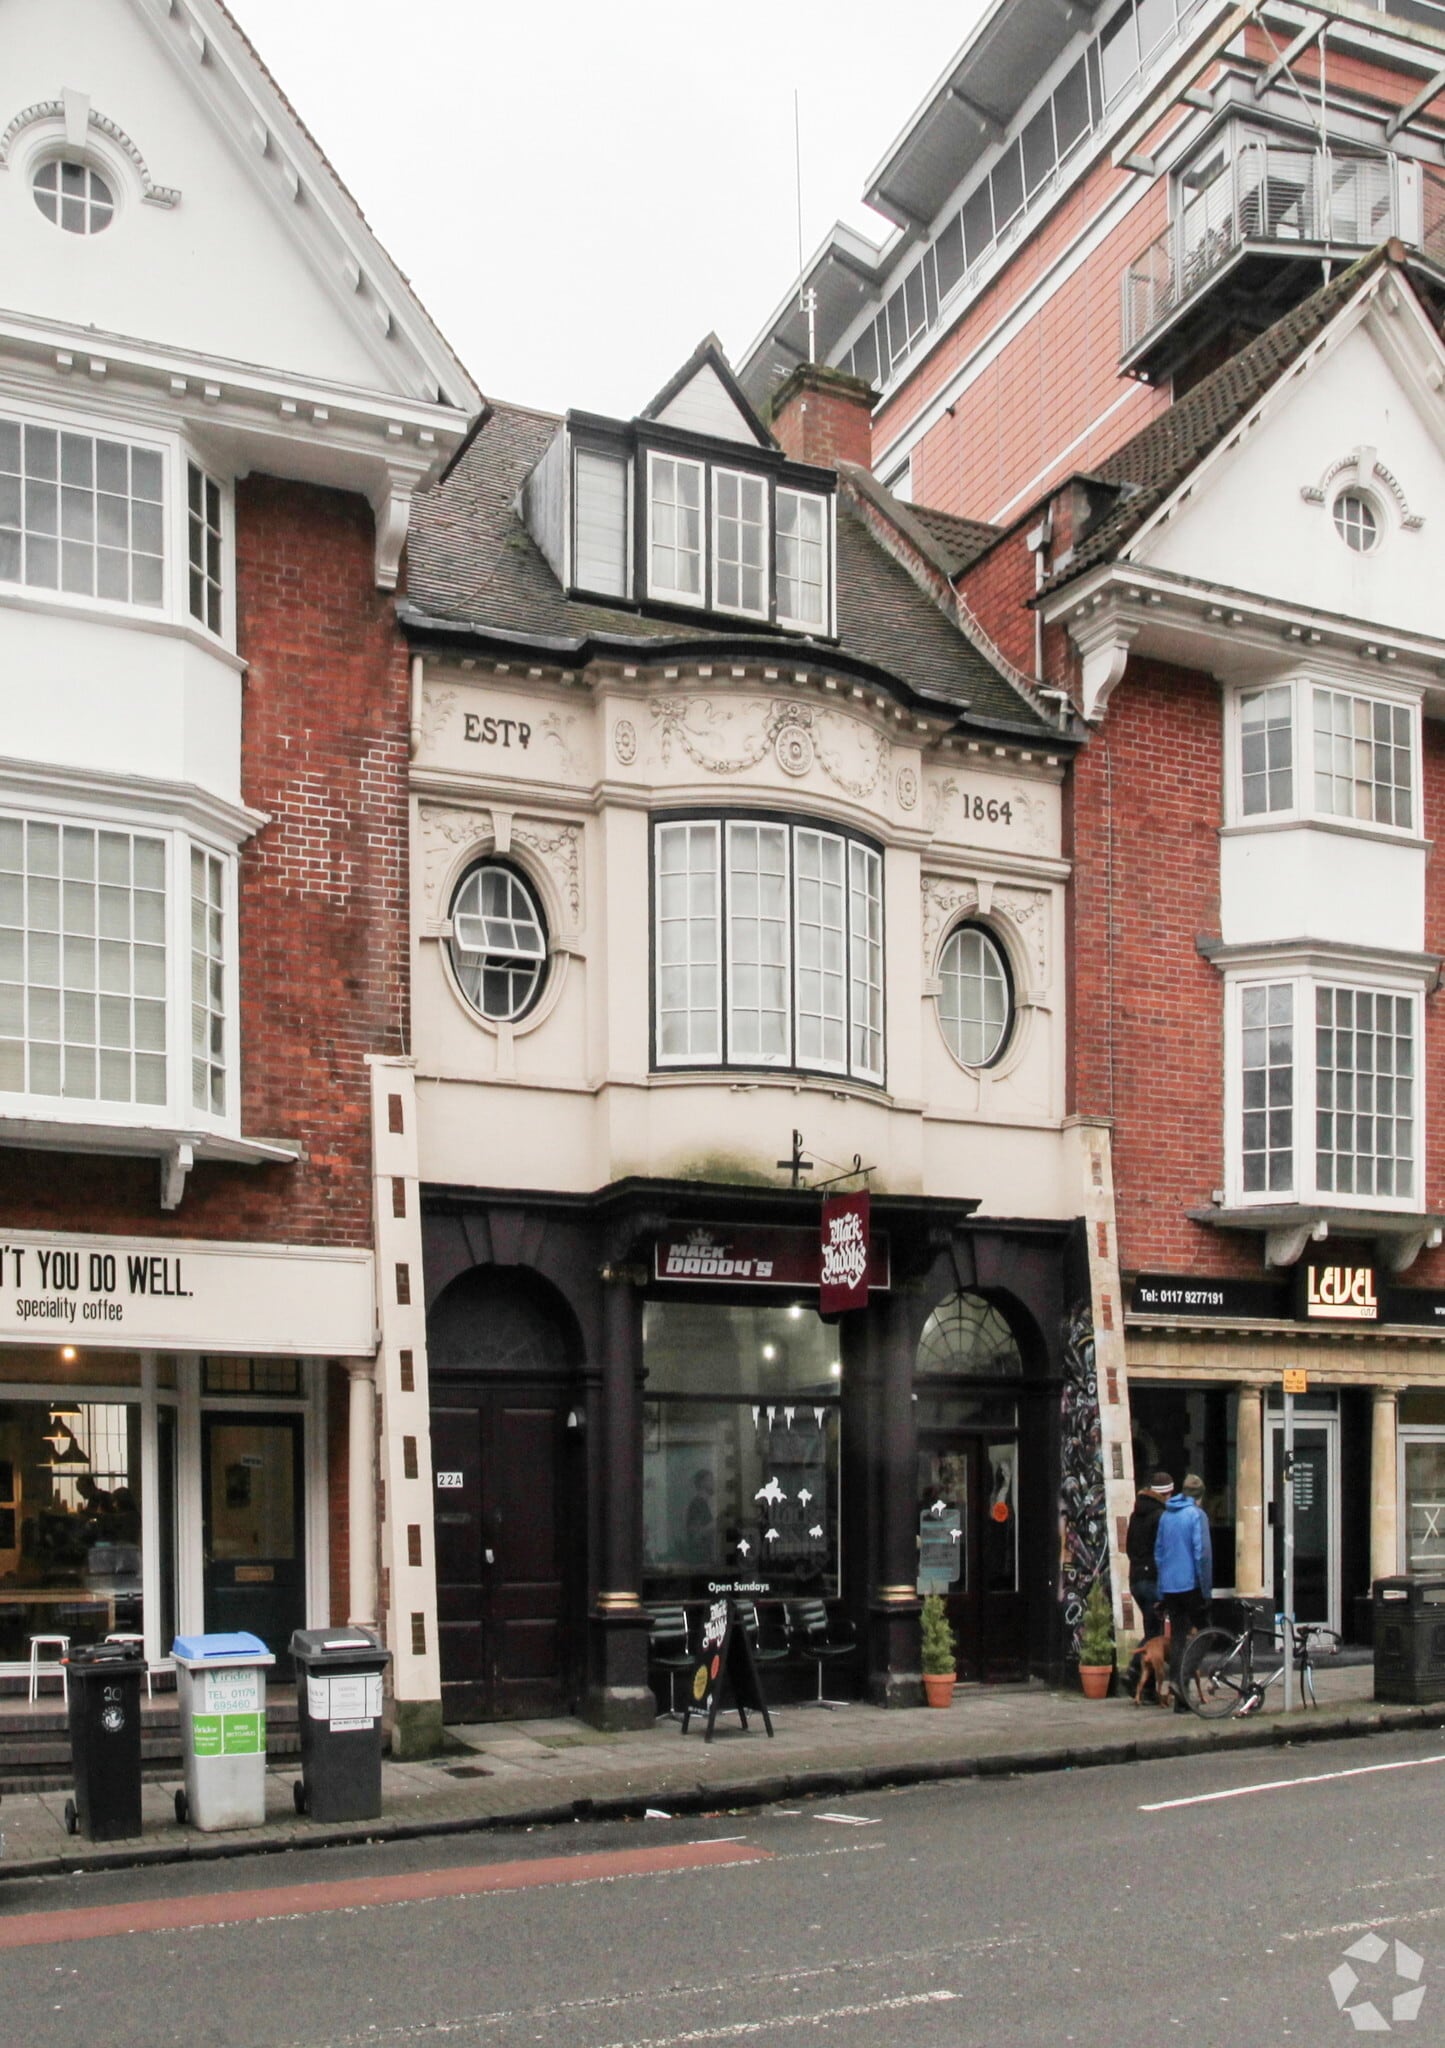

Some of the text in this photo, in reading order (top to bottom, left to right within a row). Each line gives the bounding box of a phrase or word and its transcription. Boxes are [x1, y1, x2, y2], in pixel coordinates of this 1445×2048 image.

[963, 794, 1013, 825] 1864
[669, 1244, 725, 1259] MACK
[37, 1250, 80, 1291] YOU
[90, 1253, 116, 1292] DO
[127, 1255, 194, 1297] WELL.
[1308, 1265, 1378, 1306] LEVEL
[1140, 1288, 1224, 1305] Tel: 0117 9277191
[16, 1296, 123, 1323] speciality coffee
[439, 1474, 462, 1486] 22A
[708, 1580, 770, 1594] Open Sundays
[103, 1686, 122, 1701] 20
[231, 1687, 256, 1699] 01179
